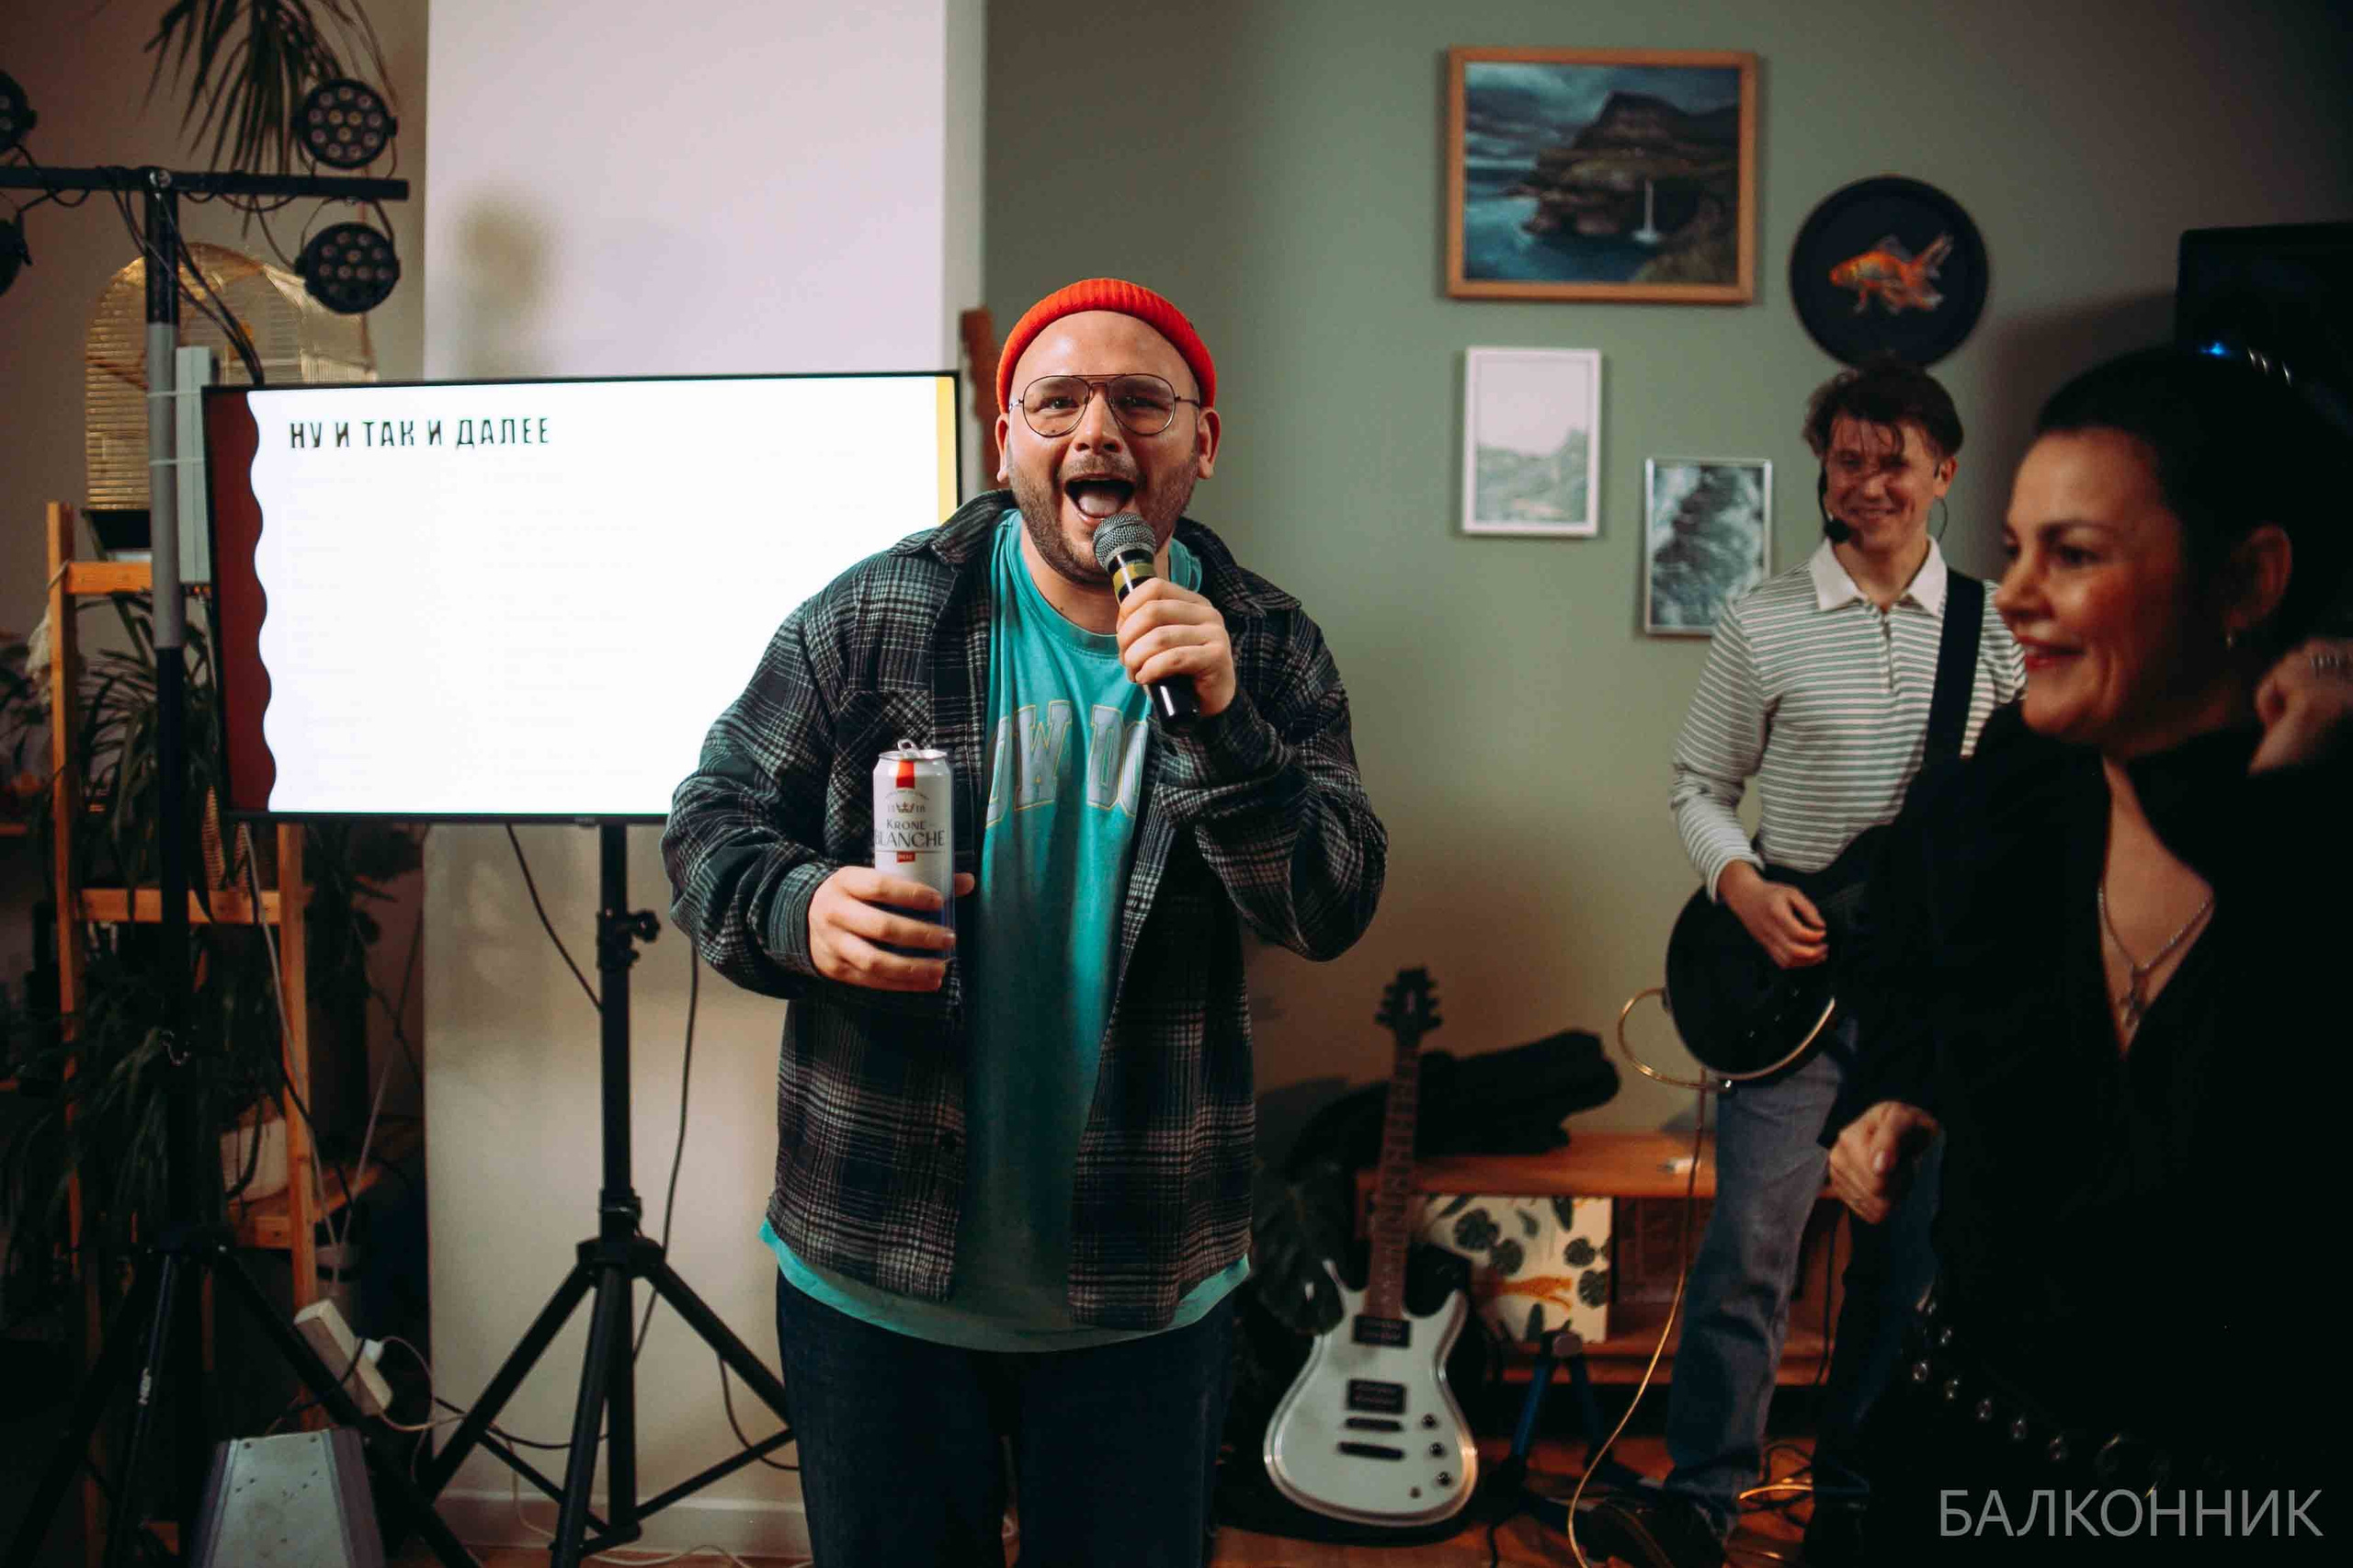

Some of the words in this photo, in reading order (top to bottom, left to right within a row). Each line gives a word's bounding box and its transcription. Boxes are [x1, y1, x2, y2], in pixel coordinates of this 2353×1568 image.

[290, 422, 322, 448] НУ
[335, 422, 350, 448] И
[363, 420, 414, 447] ТАК
[428, 419, 442, 446] И
[455, 417, 549, 450] ДАЛЕЕ
[874, 829, 945, 847] BLANCHE
